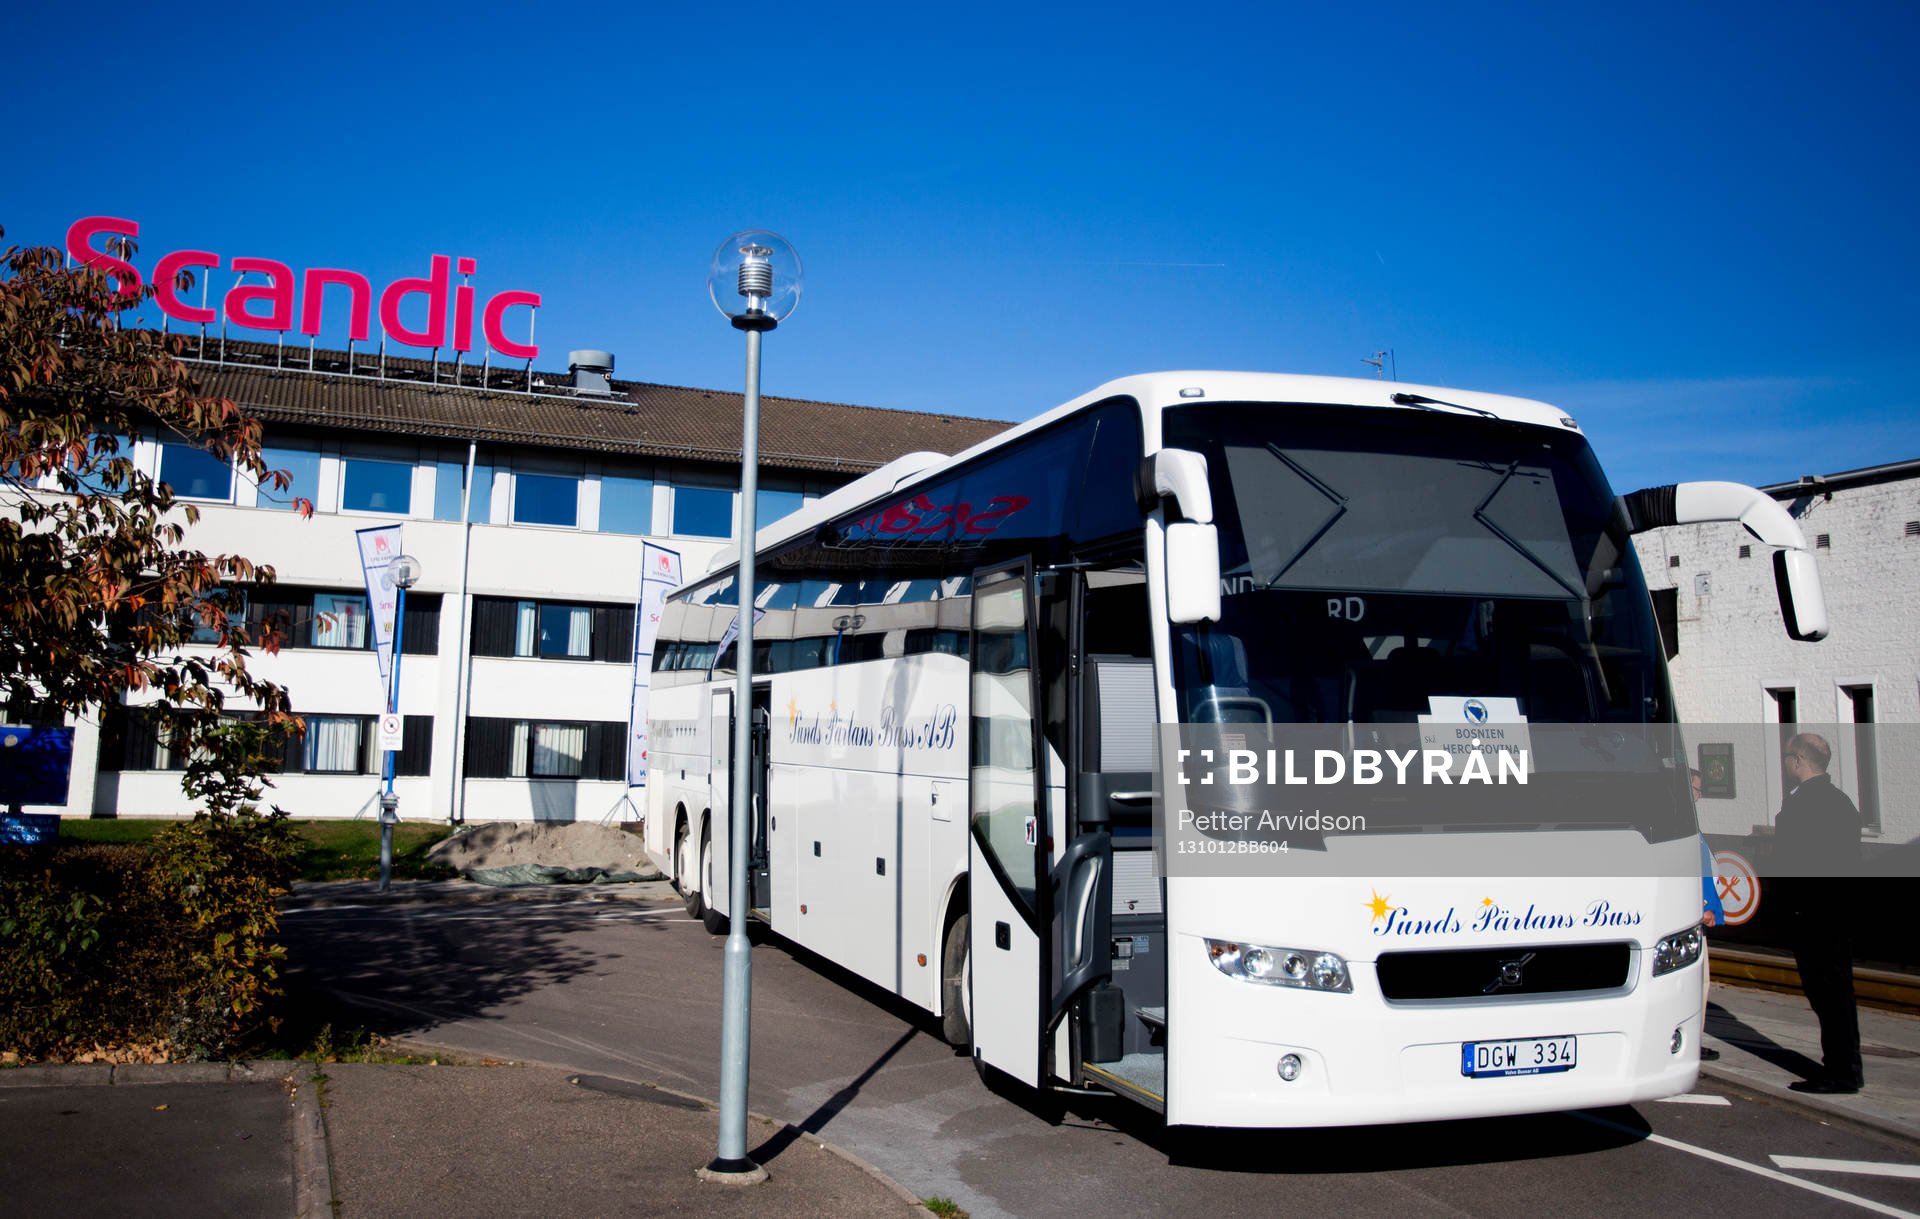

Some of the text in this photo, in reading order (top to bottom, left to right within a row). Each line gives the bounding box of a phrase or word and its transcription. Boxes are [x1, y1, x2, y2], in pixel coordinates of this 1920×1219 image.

[66, 216, 541, 358] Scandic
[917, 703, 957, 750] AB
[1455, 728, 1505, 739] BOSNIEN
[1374, 899, 1647, 936] Sunds Pärlans Buss
[1478, 1041, 1570, 1068] DGW 334
